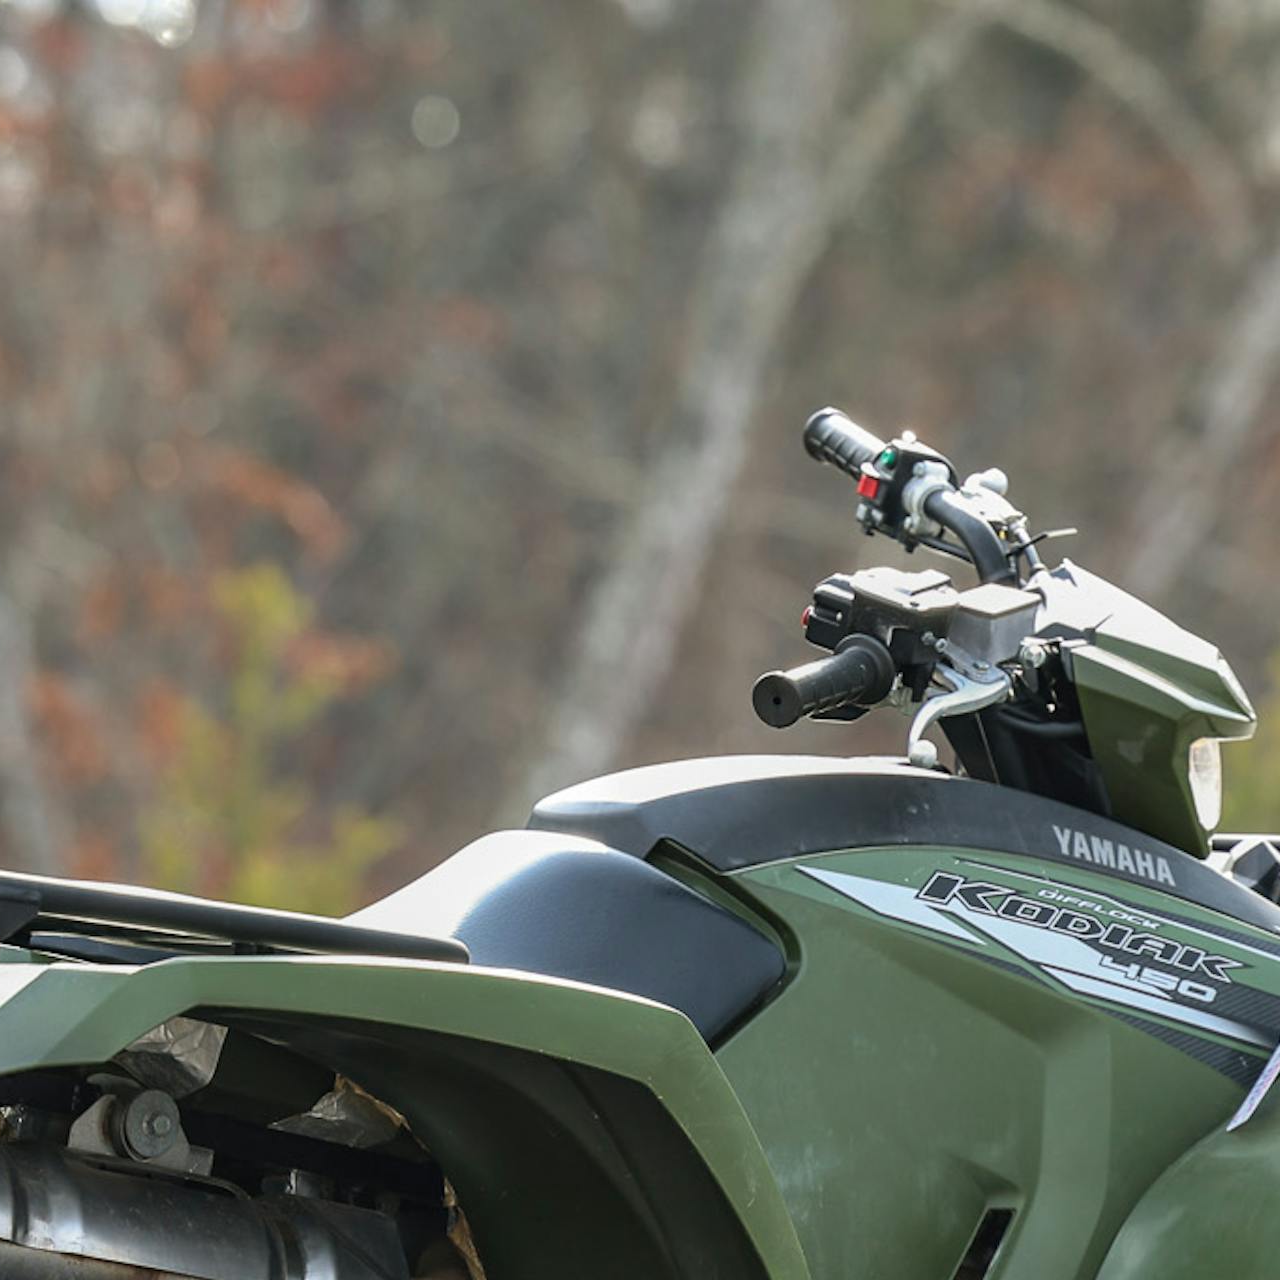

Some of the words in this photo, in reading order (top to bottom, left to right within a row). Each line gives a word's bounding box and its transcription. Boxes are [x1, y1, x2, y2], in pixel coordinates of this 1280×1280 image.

[1051, 823, 1177, 887] YAMAHA
[914, 870, 1252, 983] KODIAK
[1099, 953, 1219, 1004] 450
